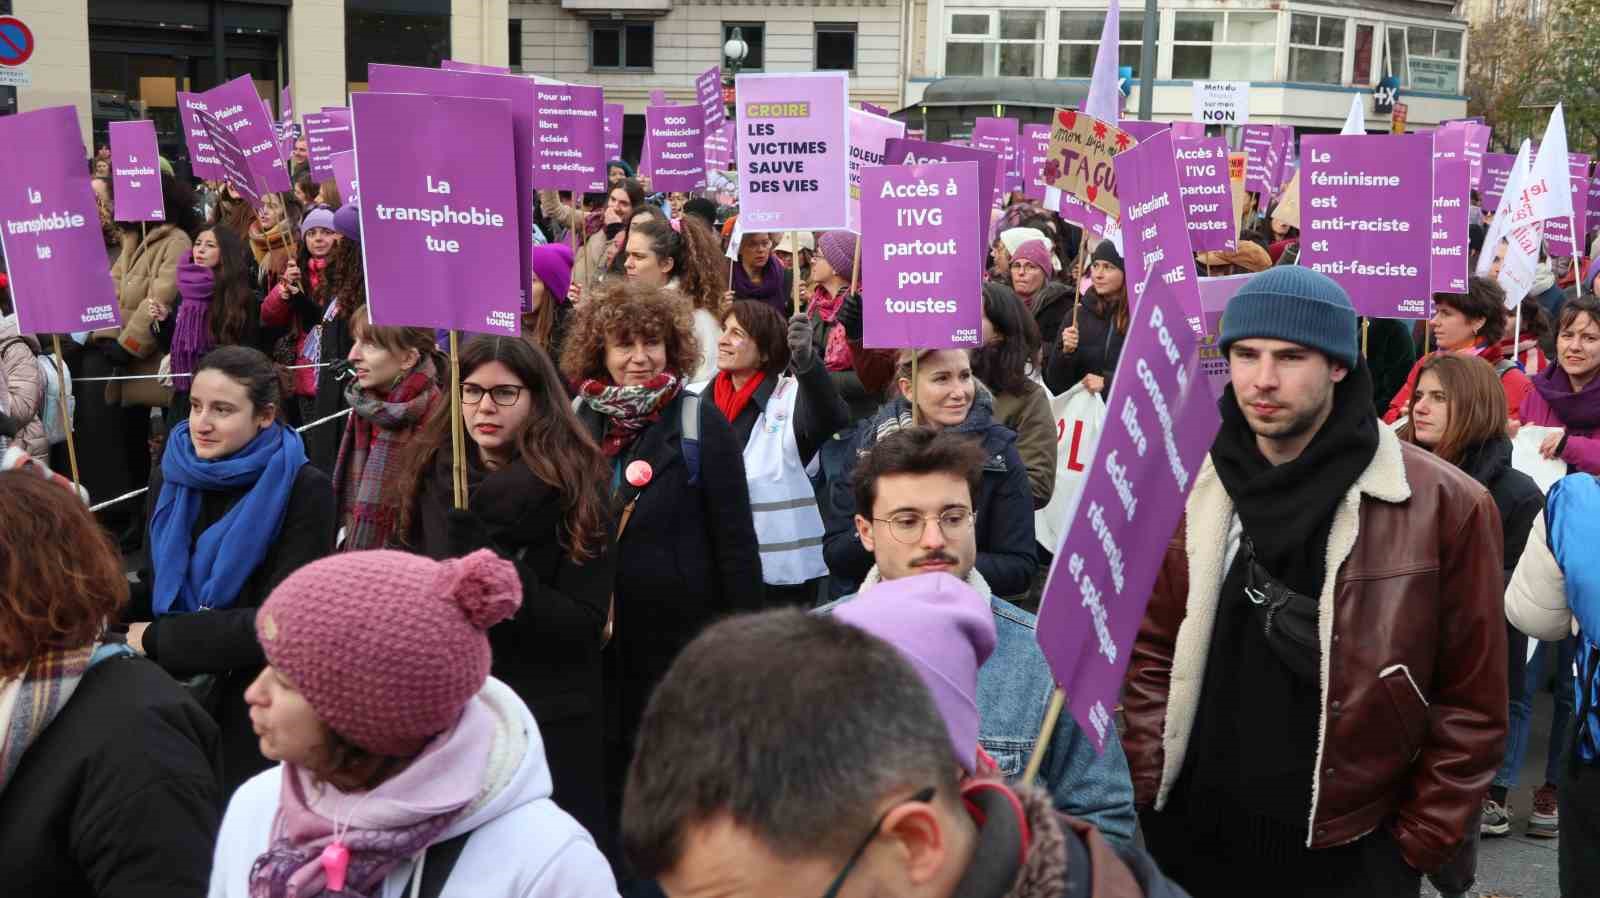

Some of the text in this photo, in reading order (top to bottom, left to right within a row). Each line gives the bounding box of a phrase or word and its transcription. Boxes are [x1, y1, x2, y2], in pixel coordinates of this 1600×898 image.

[1225, 83, 1237, 91] du
[538, 92, 572, 102] Pour un
[186, 99, 208, 111] Accès
[747, 103, 809, 117] CROIRE
[214, 104, 243, 121] Plainte
[538, 107, 598, 117] consentement
[1203, 110, 1236, 121] NON
[539, 120, 558, 129] libre
[664, 116, 687, 125] 1000
[191, 128, 209, 139] part
[652, 128, 701, 137] féminicides
[748, 123, 775, 136] LES
[540, 134, 569, 143] éclairé
[252, 139, 274, 153] crois
[748, 141, 827, 155] VICTIMES
[128, 155, 138, 163] La
[540, 149, 582, 158] réversible
[661, 151, 694, 160] Macron
[1176, 146, 1225, 160] Accès à
[1311, 148, 1331, 164] Le
[553, 163, 595, 174] spécifique
[748, 161, 805, 174] SAUVE
[1186, 165, 1217, 178] l'IVG
[426, 175, 451, 195] La
[1310, 170, 1401, 187] féminisme
[749, 179, 819, 193] DES VIES
[880, 179, 940, 199] Accès
[946, 177, 959, 196] à
[1180, 183, 1226, 198] partout
[28, 187, 42, 205] La
[1311, 196, 1338, 209] est
[1432, 196, 1461, 208] nfant
[1189, 202, 1220, 216] pour
[375, 203, 505, 229] transphobie
[896, 208, 944, 228] l'IVG
[7, 210, 86, 237] transphobie
[1187, 219, 1229, 231] oustes
[1311, 217, 1410, 232] anti-raciste
[1545, 220, 1570, 231] pour
[1432, 229, 1449, 240] ais
[1544, 232, 1577, 243] oustes
[424, 234, 461, 254] tue
[883, 239, 957, 261] partout
[1311, 239, 1329, 252] et
[36, 242, 53, 261] tue
[1311, 260, 1418, 277] anti-fasciste
[897, 271, 944, 289] pour
[885, 297, 958, 314] toustes
[1398, 304, 1425, 313] toutes
[1403, 298, 1425, 307] nous
[87, 304, 114, 315] nous
[492, 311, 516, 320] nous
[80, 311, 115, 323] toutes
[486, 316, 516, 328] toutes
[951, 334, 978, 342] toutes
[956, 328, 977, 336] nous
[1149, 304, 1180, 364] Pour
[1119, 394, 1148, 458] libre
[1135, 357, 1189, 493] consentement
[1104, 447, 1137, 522] éclairé
[1086, 500, 1126, 595] réversible
[1068, 551, 1118, 665] et spécifique
